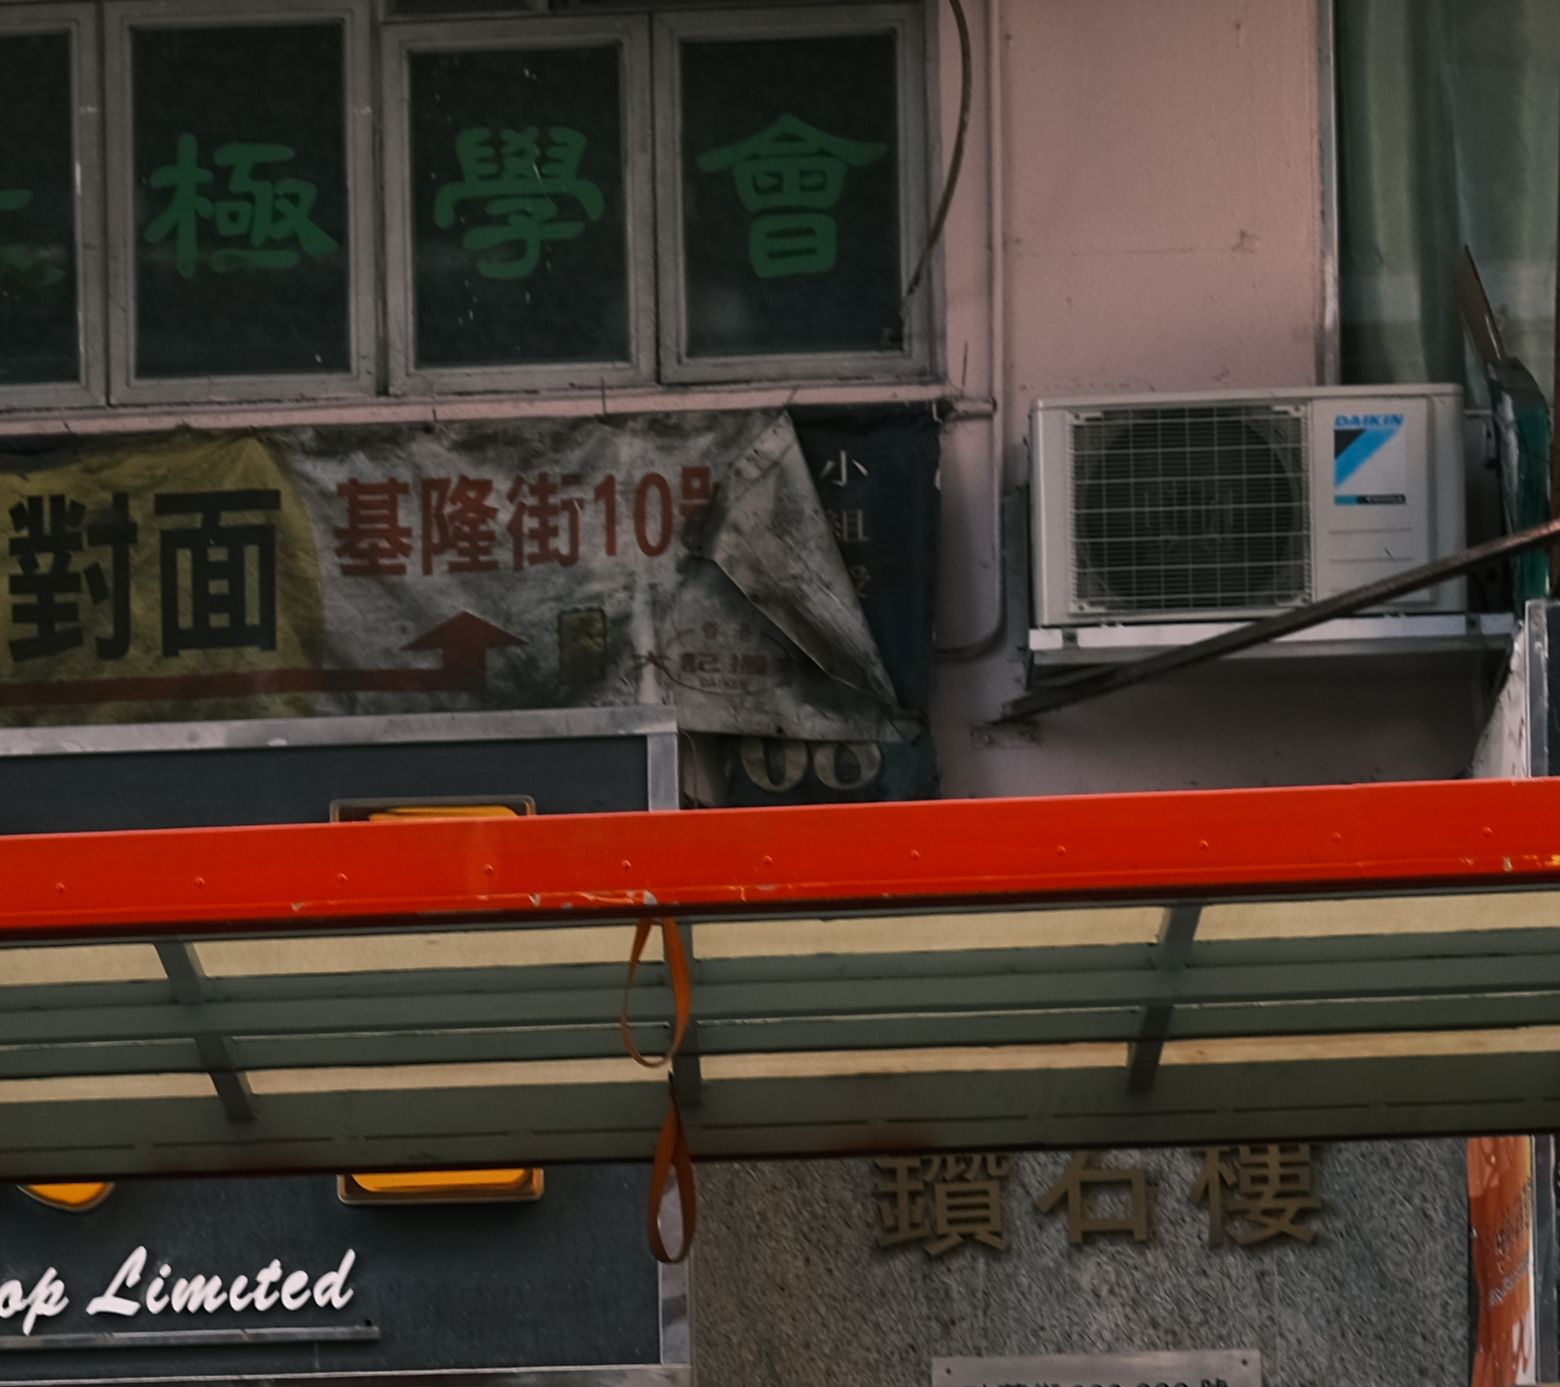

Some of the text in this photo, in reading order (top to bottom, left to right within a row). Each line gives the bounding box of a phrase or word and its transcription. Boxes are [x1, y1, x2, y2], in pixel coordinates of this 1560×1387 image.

[1334, 412, 1404, 428] DAIKIN
[876, 1144, 1322, 1257] 鑽石樓
[86, 1245, 357, 1318] Limited
